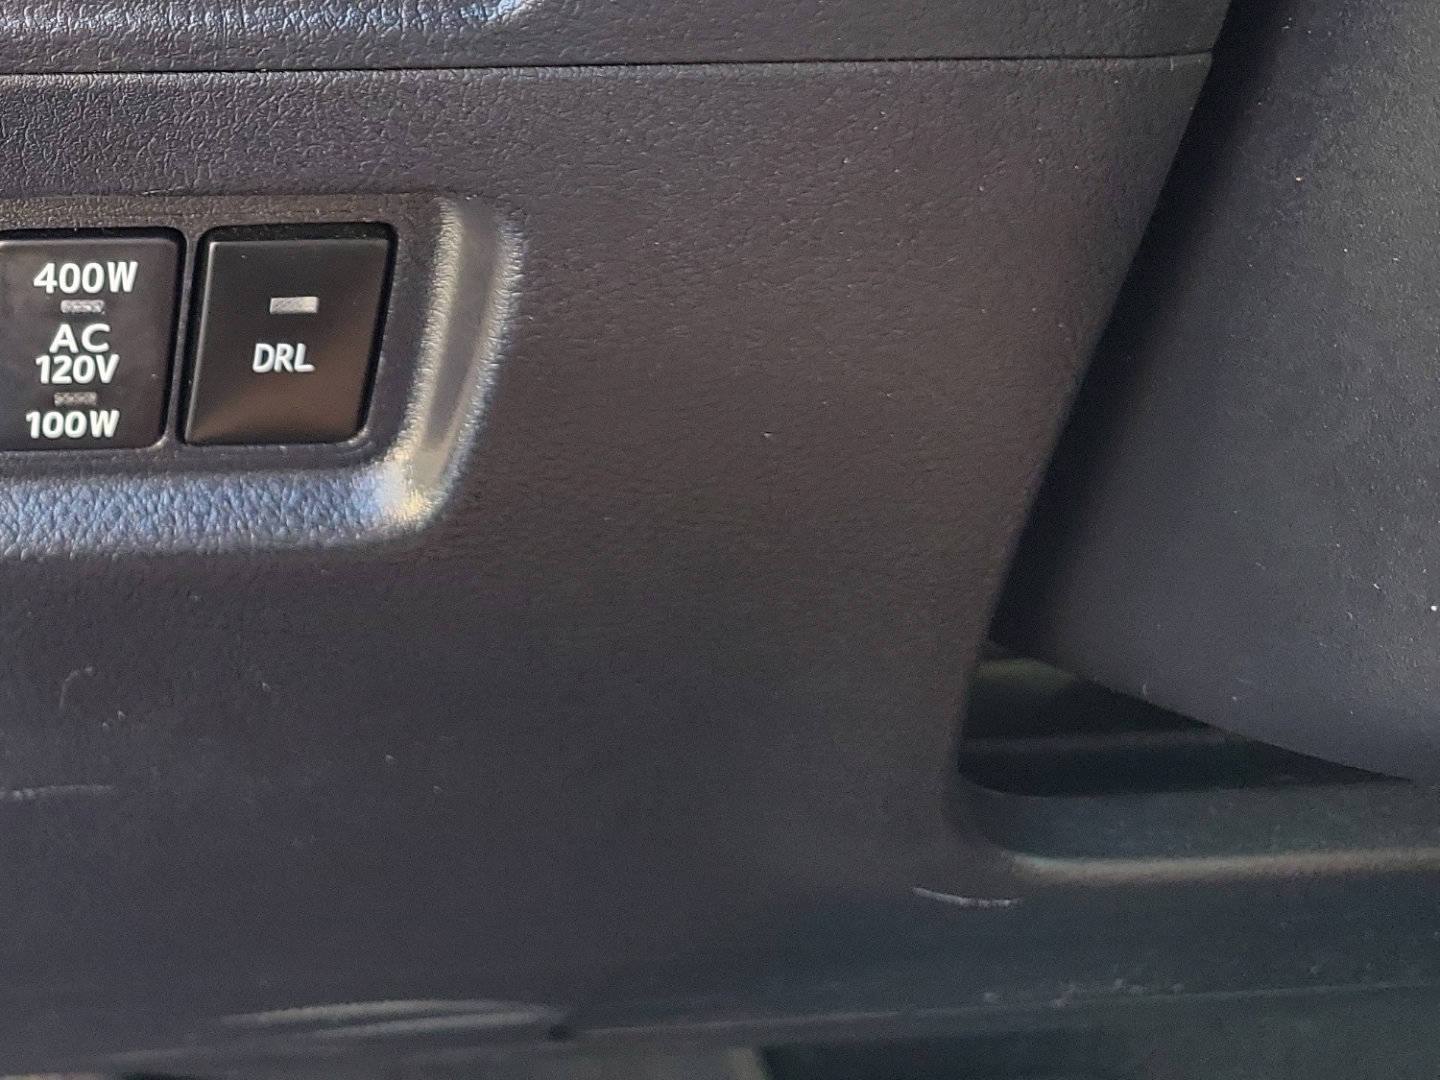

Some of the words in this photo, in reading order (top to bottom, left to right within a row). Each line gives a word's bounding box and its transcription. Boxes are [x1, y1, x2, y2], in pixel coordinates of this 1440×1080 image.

[33, 261, 138, 294] 400W
[49, 323, 111, 354] AC
[35, 353, 120, 384] 120V
[252, 342, 316, 373] DRL
[26, 409, 120, 439] 100W
